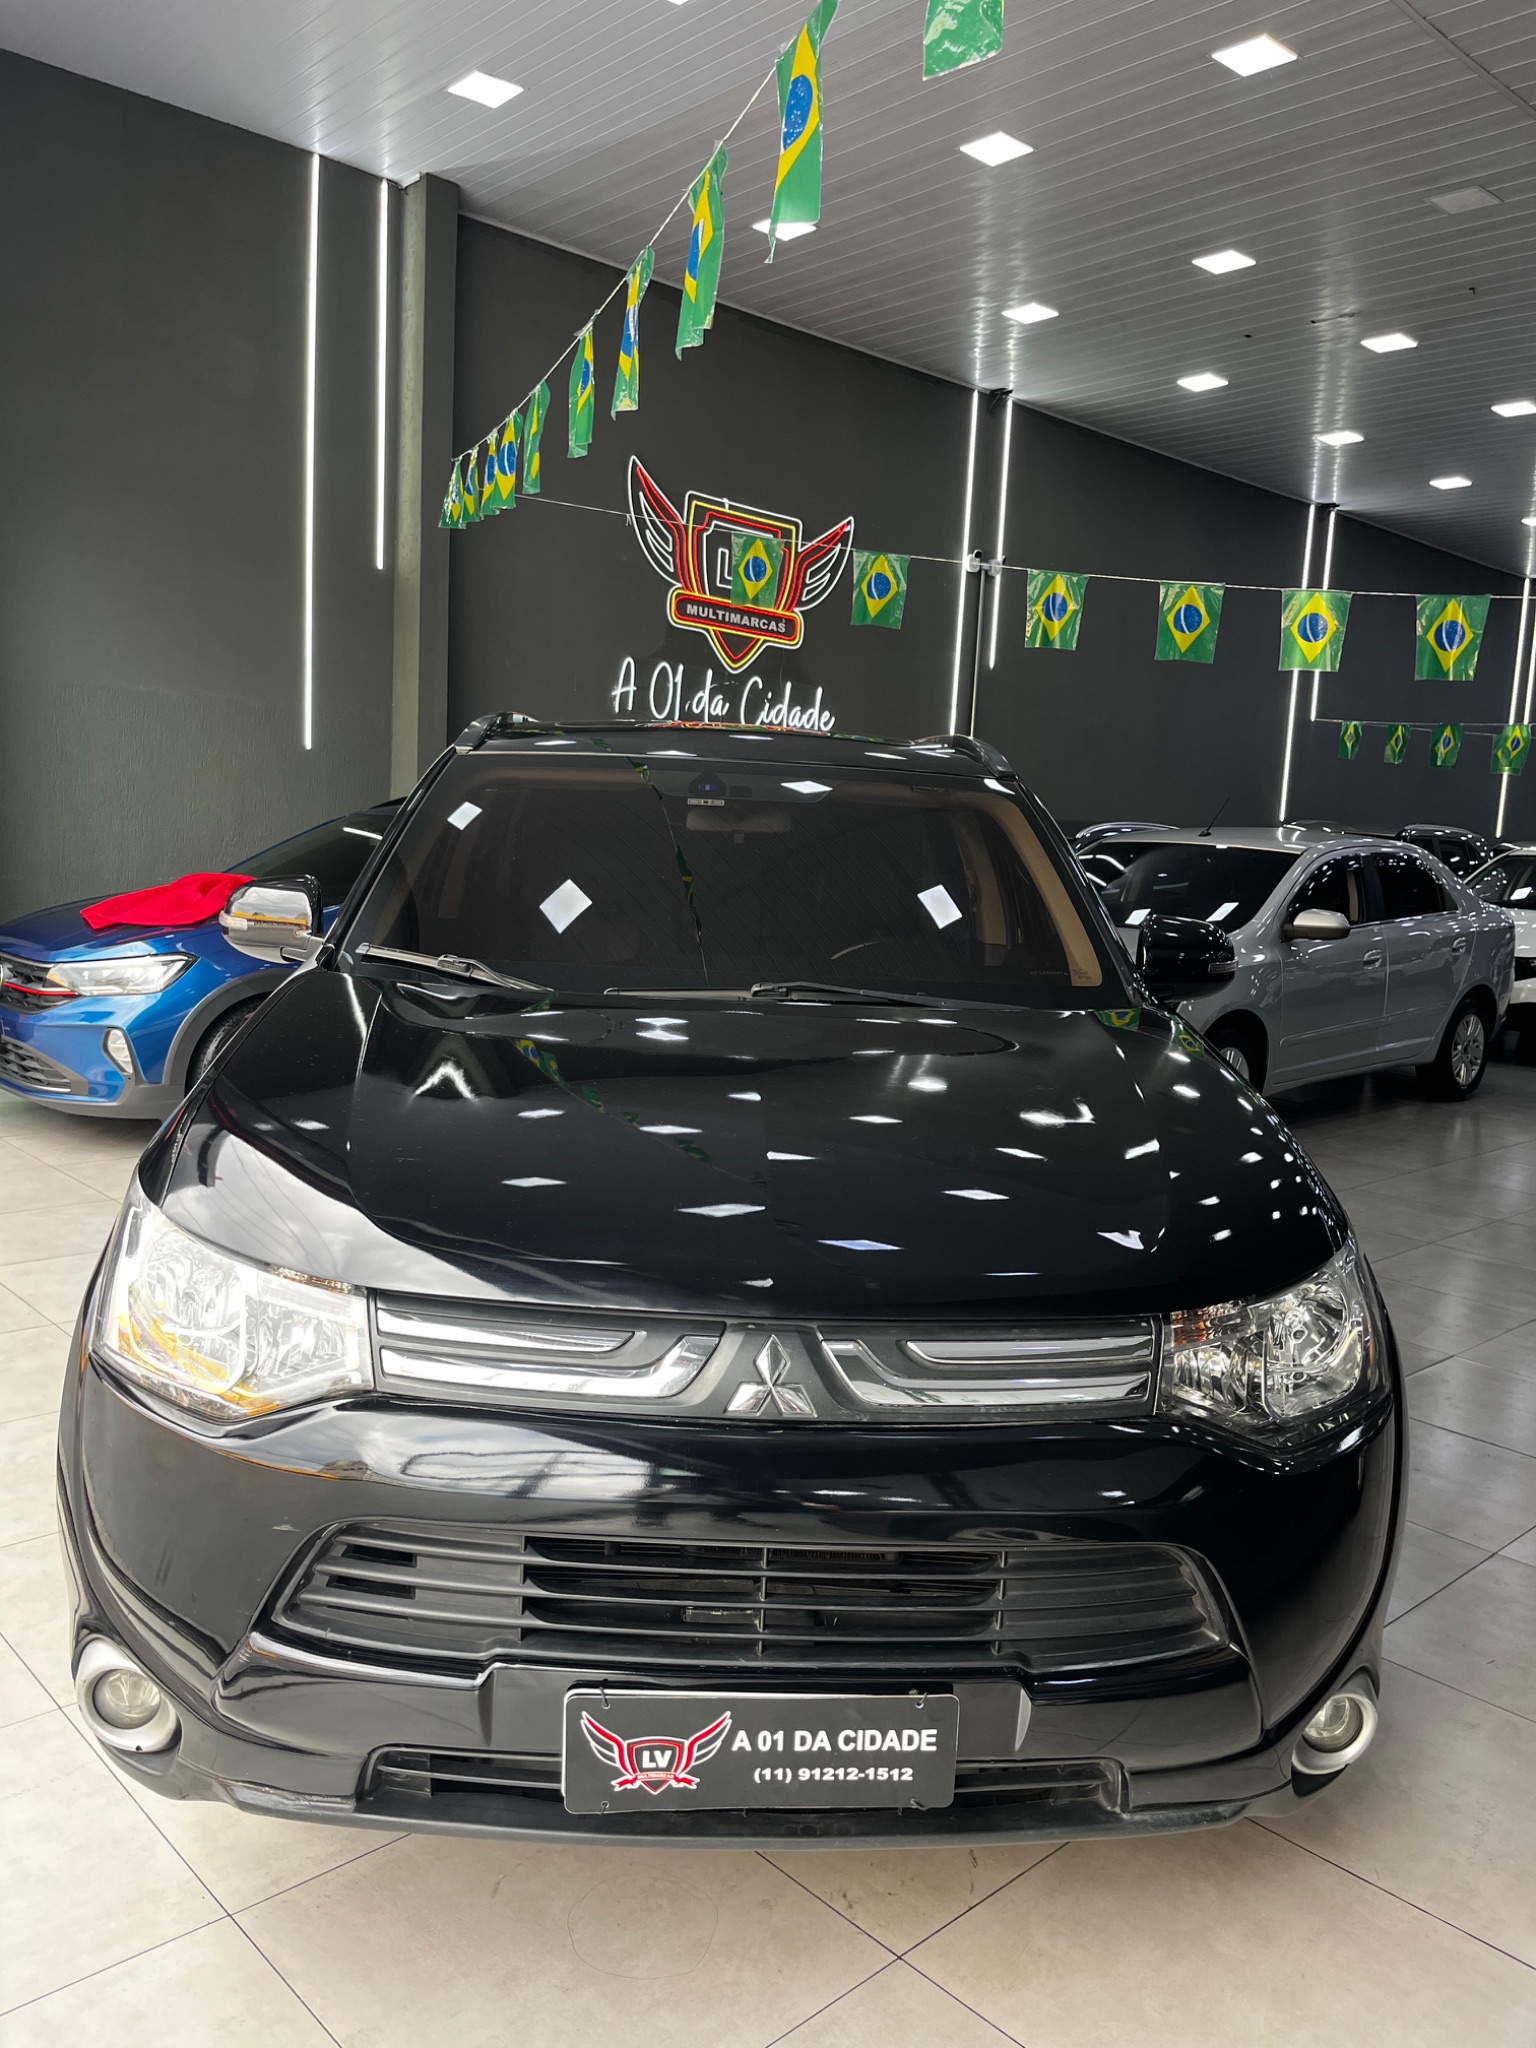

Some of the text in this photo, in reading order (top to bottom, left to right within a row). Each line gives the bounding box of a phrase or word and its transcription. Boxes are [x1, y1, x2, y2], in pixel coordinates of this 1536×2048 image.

[686, 604, 786, 633] MULTIMARCAS
[611, 656, 637, 713] A
[692, 668, 730, 723] da
[740, 676, 836, 731] Cidade
[731, 1729, 938, 1752] A 01 DA CIDADE
[642, 1750, 673, 1769] LV
[753, 1767, 914, 1784] (11) 91212-1512
